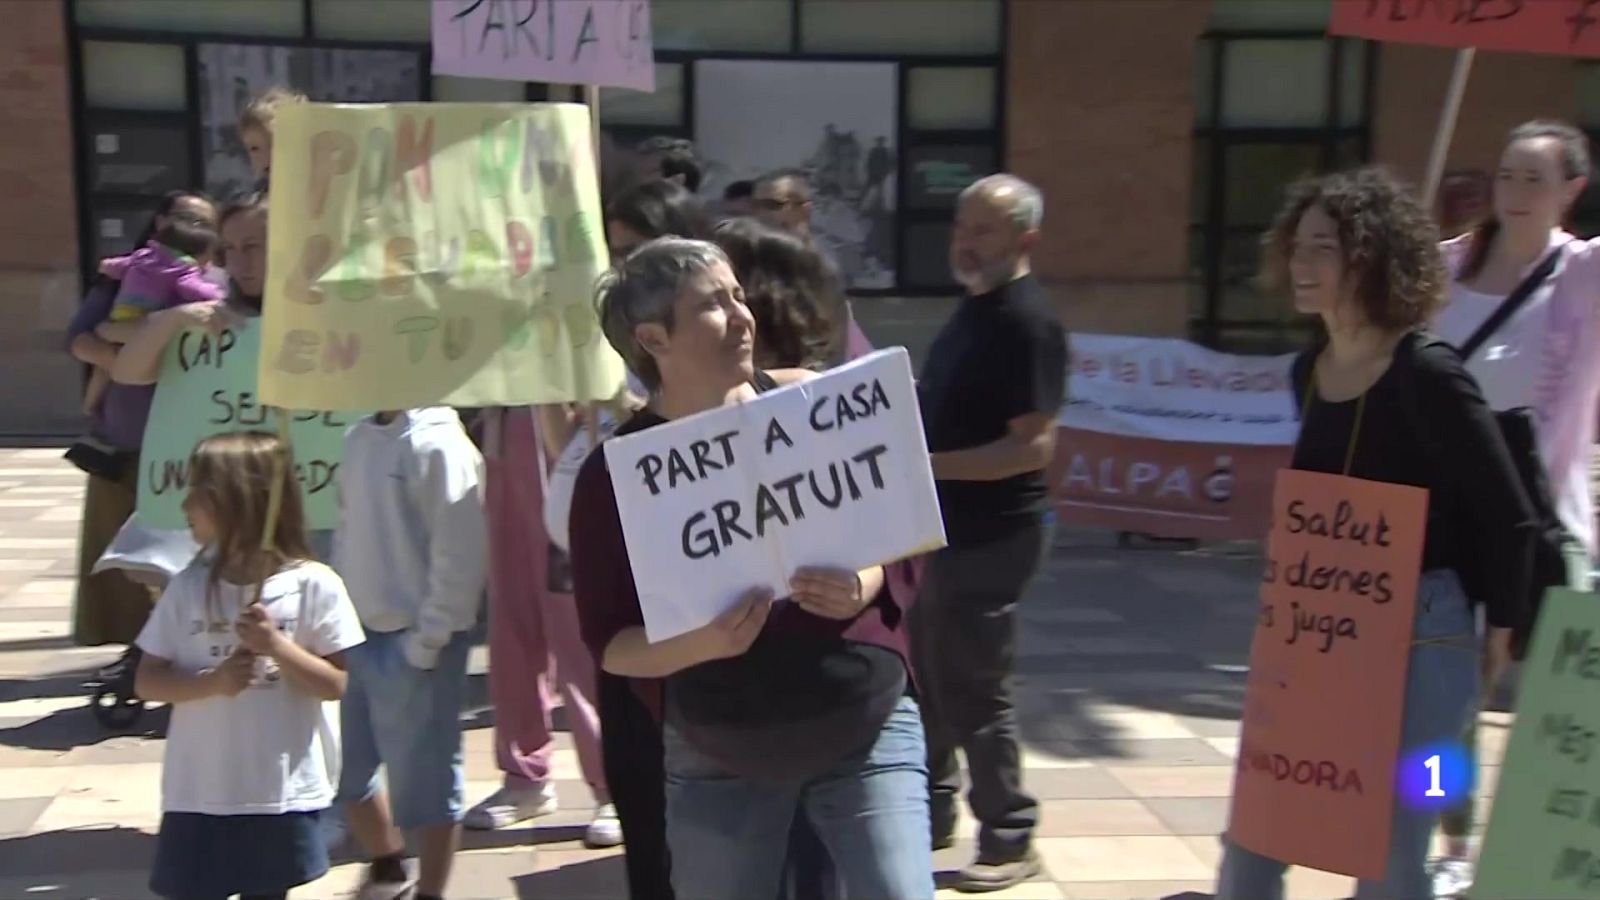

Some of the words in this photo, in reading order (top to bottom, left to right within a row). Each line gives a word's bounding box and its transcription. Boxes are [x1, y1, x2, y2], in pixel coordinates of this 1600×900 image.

[177, 328, 236, 373] CAP
[273, 327, 361, 376] EN
[635, 430, 740, 496] PART
[764, 416, 794, 455] A
[809, 378, 891, 433] CASA
[681, 444, 888, 560] GRATUIT
[1285, 499, 1392, 547] Salut
[1285, 550, 1393, 604] dones
[1284, 601, 1359, 654] juga
